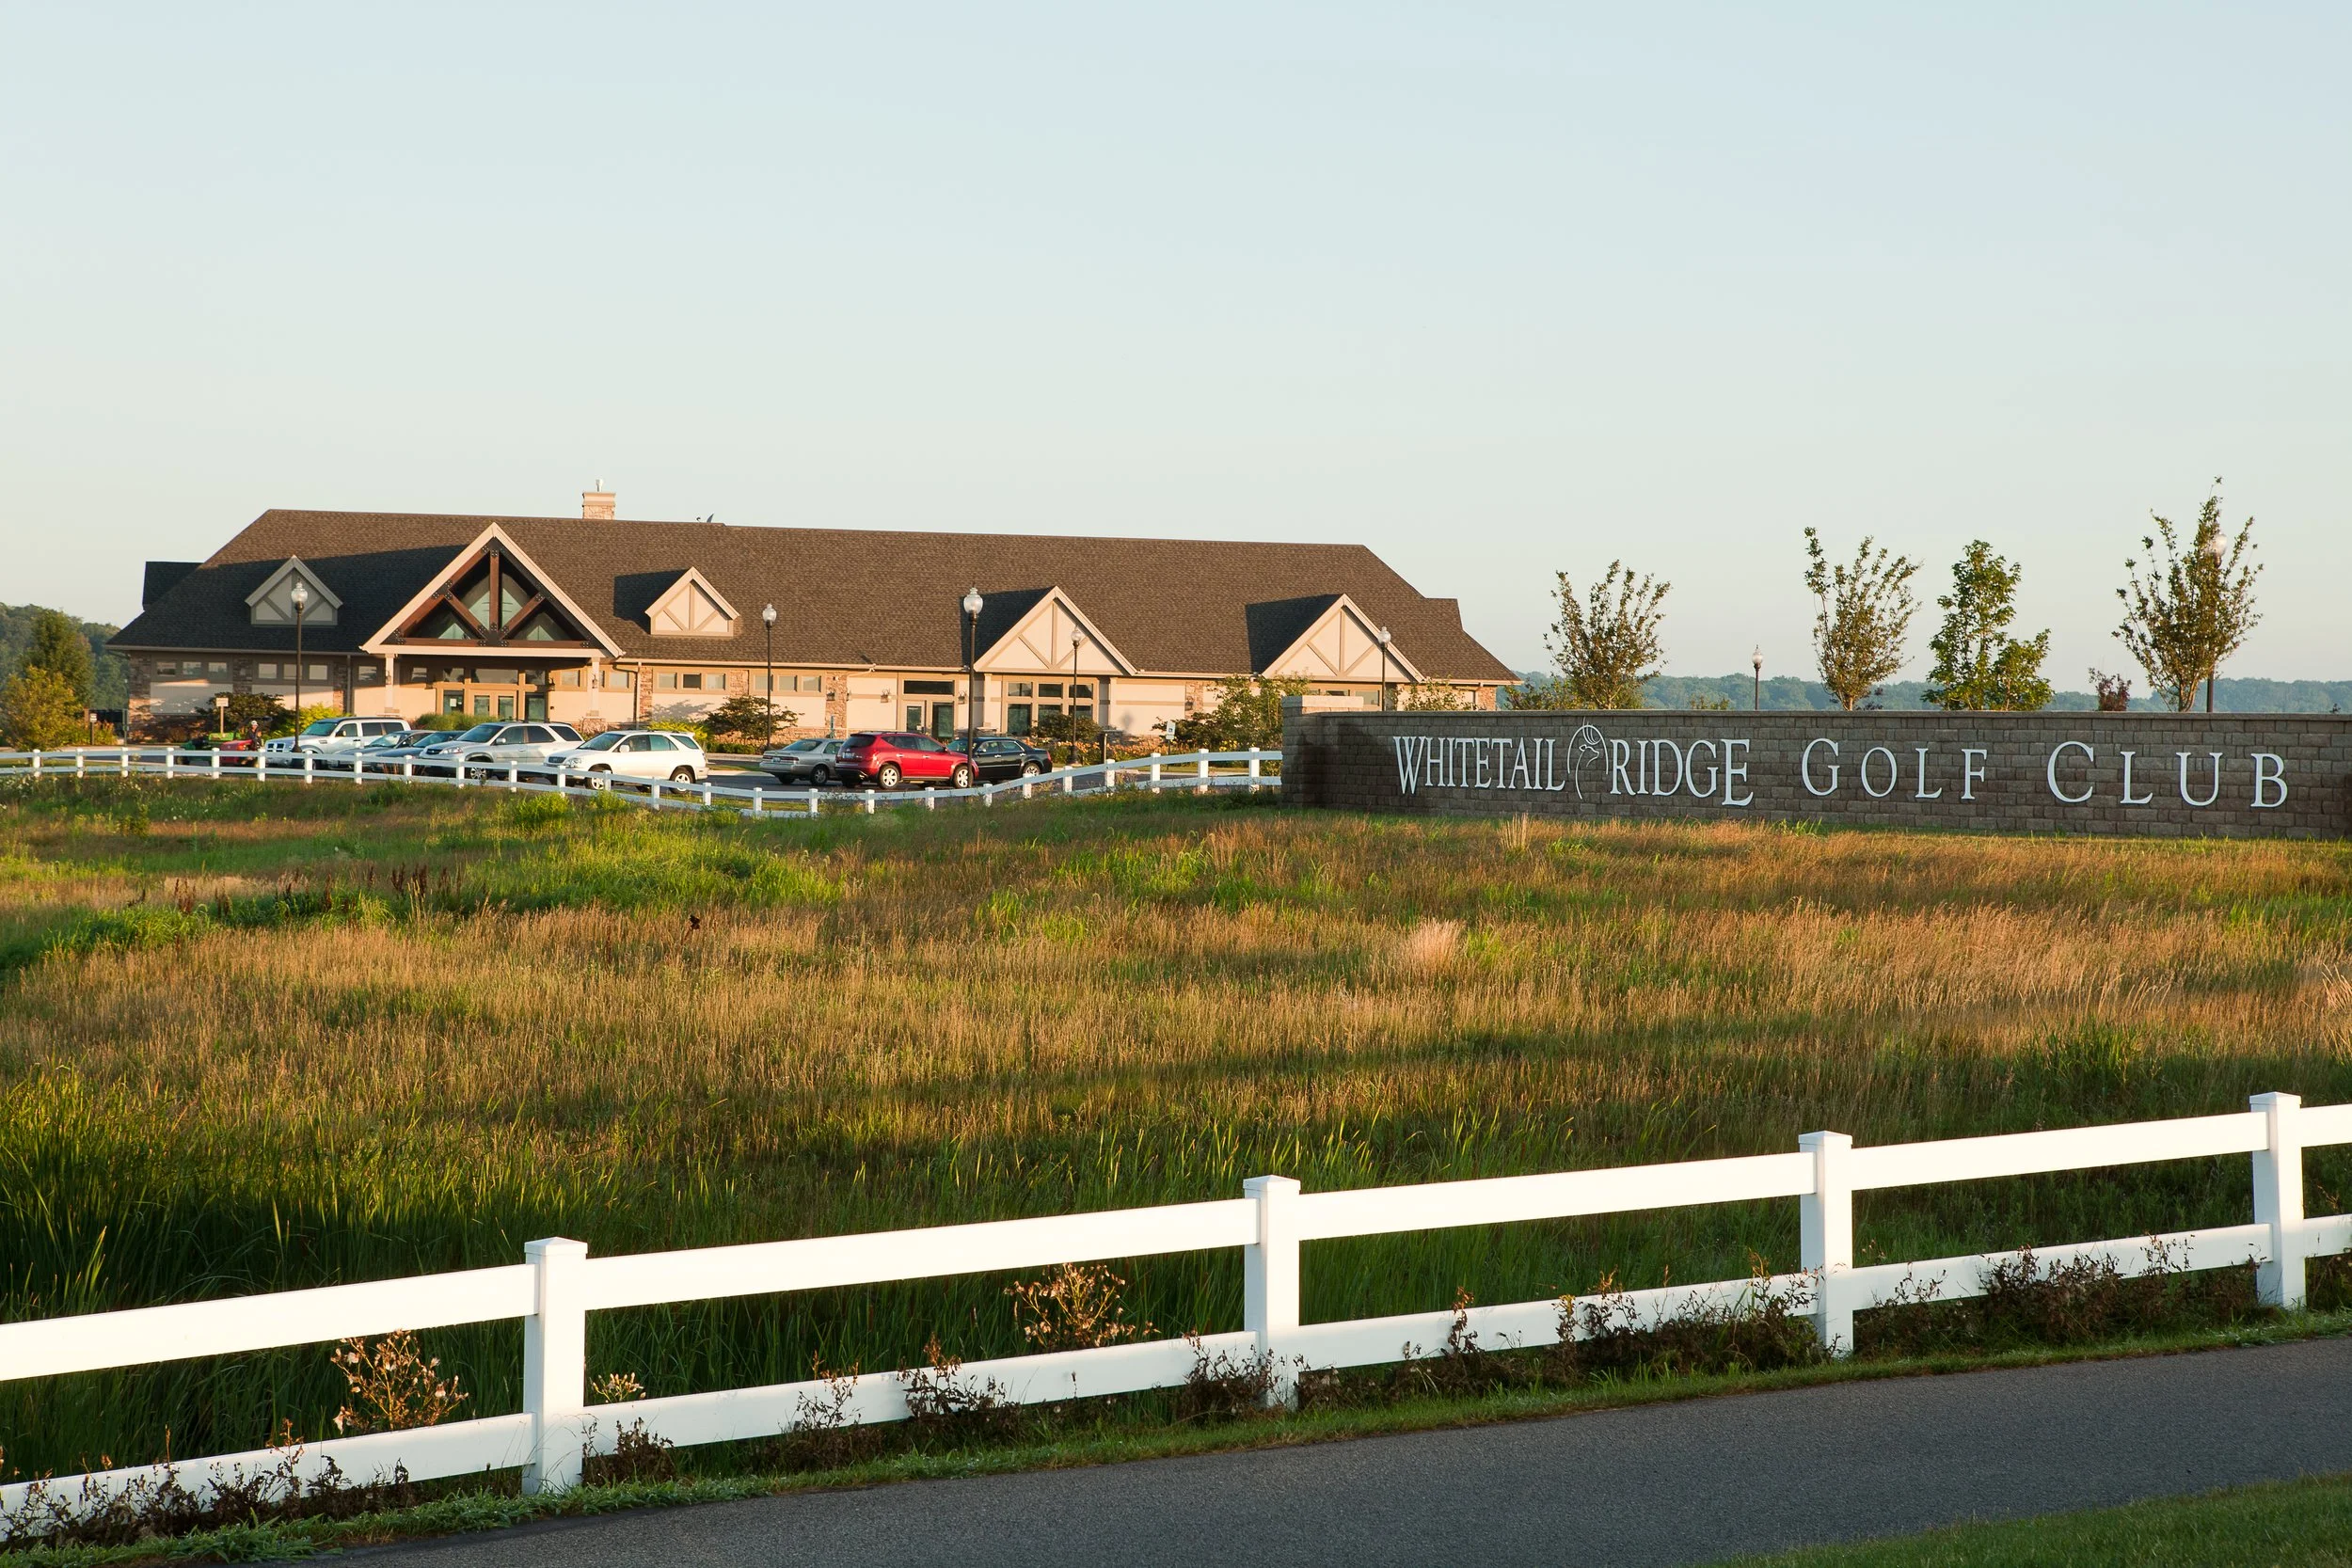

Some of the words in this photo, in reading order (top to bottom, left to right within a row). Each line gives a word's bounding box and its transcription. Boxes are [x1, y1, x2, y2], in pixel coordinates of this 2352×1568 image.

[1392, 736, 1565, 794] WHITETAIL
[1610, 738, 1754, 806] RIDGE
[1802, 737, 1988, 800] GOLF
[2047, 740, 2289, 808] CLUB
